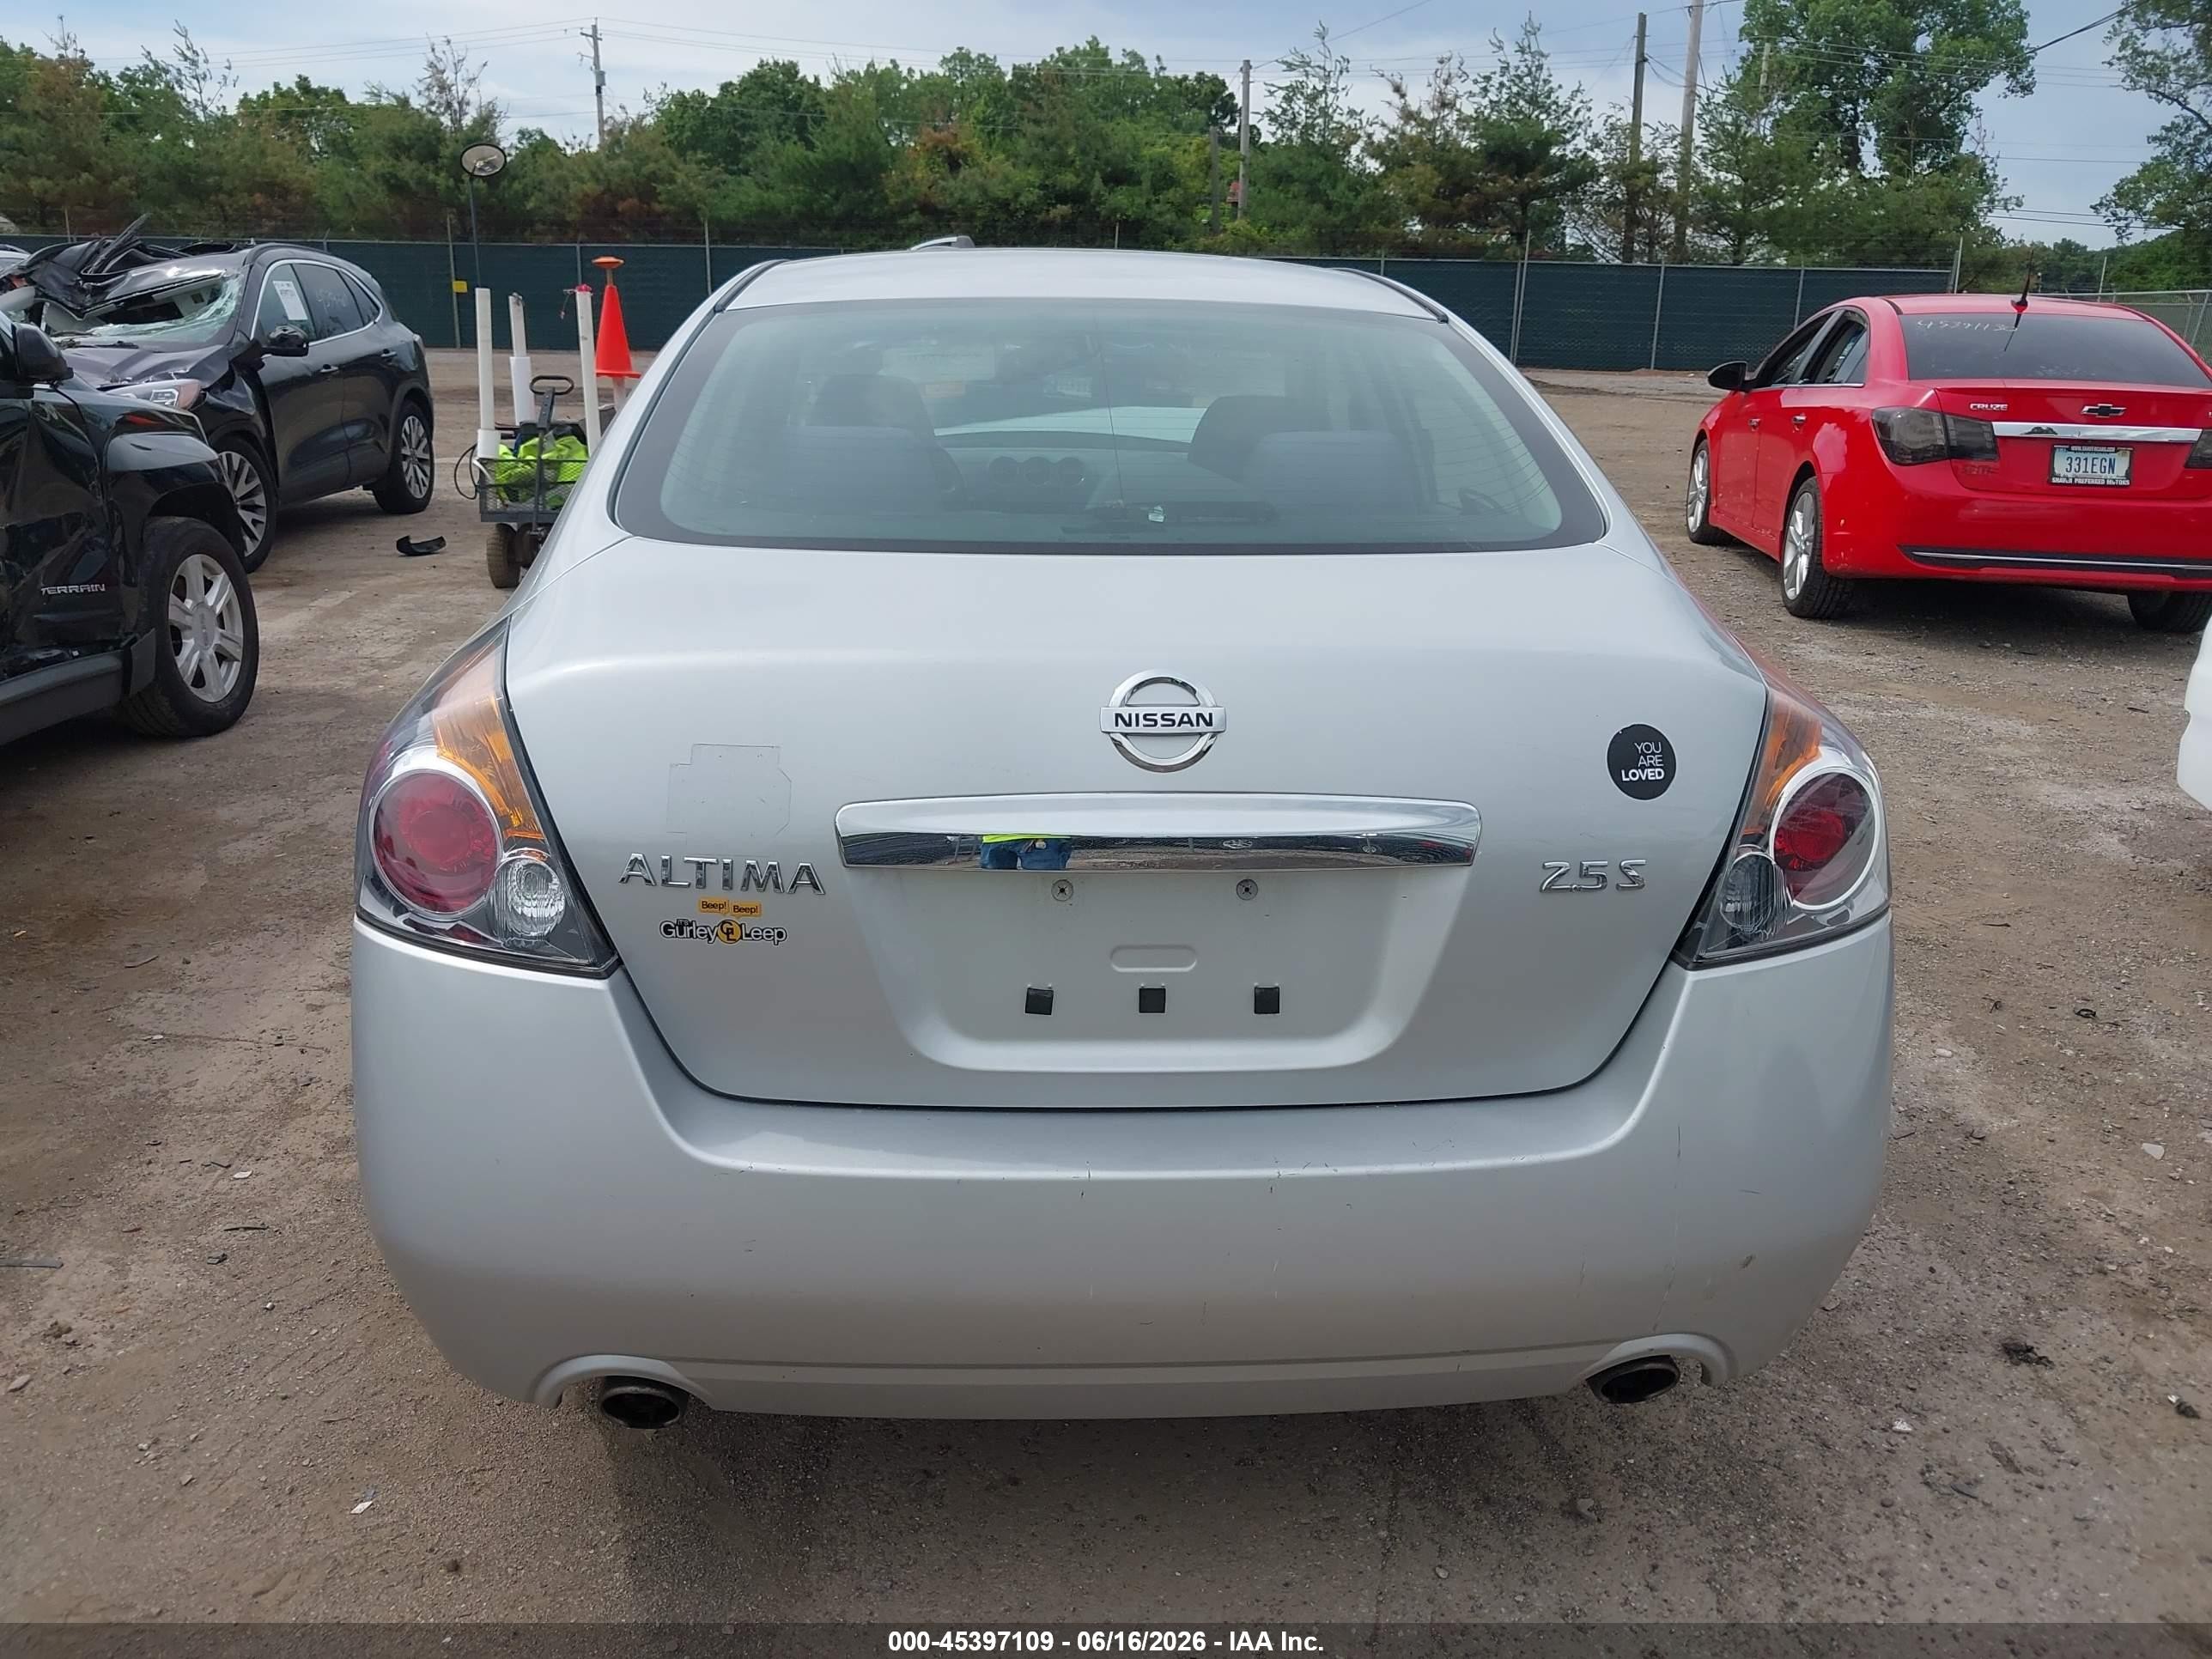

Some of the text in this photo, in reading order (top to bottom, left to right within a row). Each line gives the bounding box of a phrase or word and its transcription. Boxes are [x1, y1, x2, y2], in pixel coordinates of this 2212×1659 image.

[2065, 456, 2116, 474] 331EGN
[41, 583, 106, 595] TERRAIN
[1114, 712, 1213, 728] NISSAN
[1634, 741, 1662, 754] YOU
[1638, 755, 1664, 768] ARE
[1621, 768, 1665, 781] LOVED
[617, 853, 826, 895] ALTIMA
[1616, 860, 1647, 891] S
[701, 900, 758, 915] Beep! Beep!
[659, 921, 719, 944] Gurley
[741, 923, 788, 945] Leep
